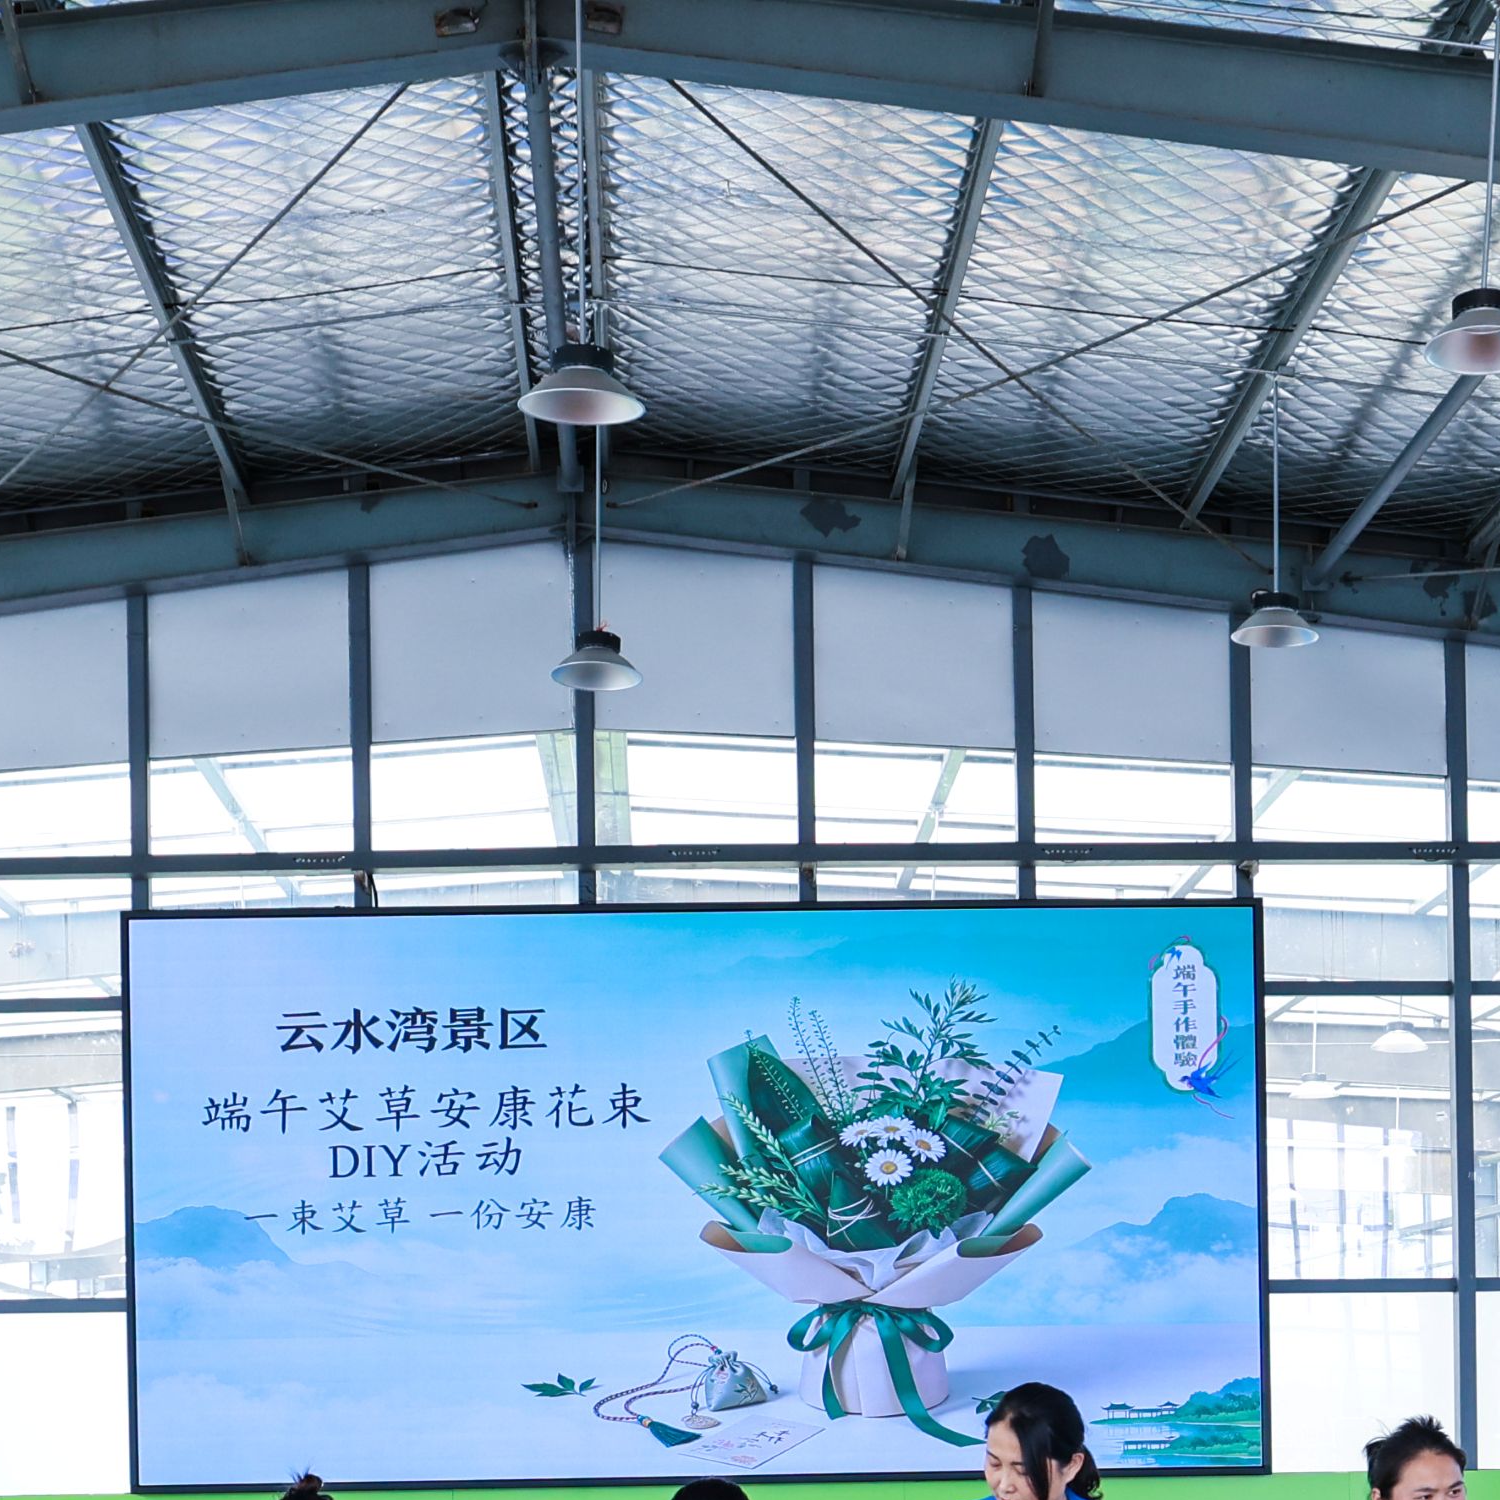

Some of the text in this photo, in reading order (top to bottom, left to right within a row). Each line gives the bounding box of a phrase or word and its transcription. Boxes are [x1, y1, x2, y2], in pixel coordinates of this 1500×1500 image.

[275, 1006, 549, 1054] 云水湾景区
[201, 1082, 652, 1134] 端午艾草安康花束
[328, 1136, 523, 1179] DIY活动
[243, 1196, 597, 1236] 一束艾草 一份安康
